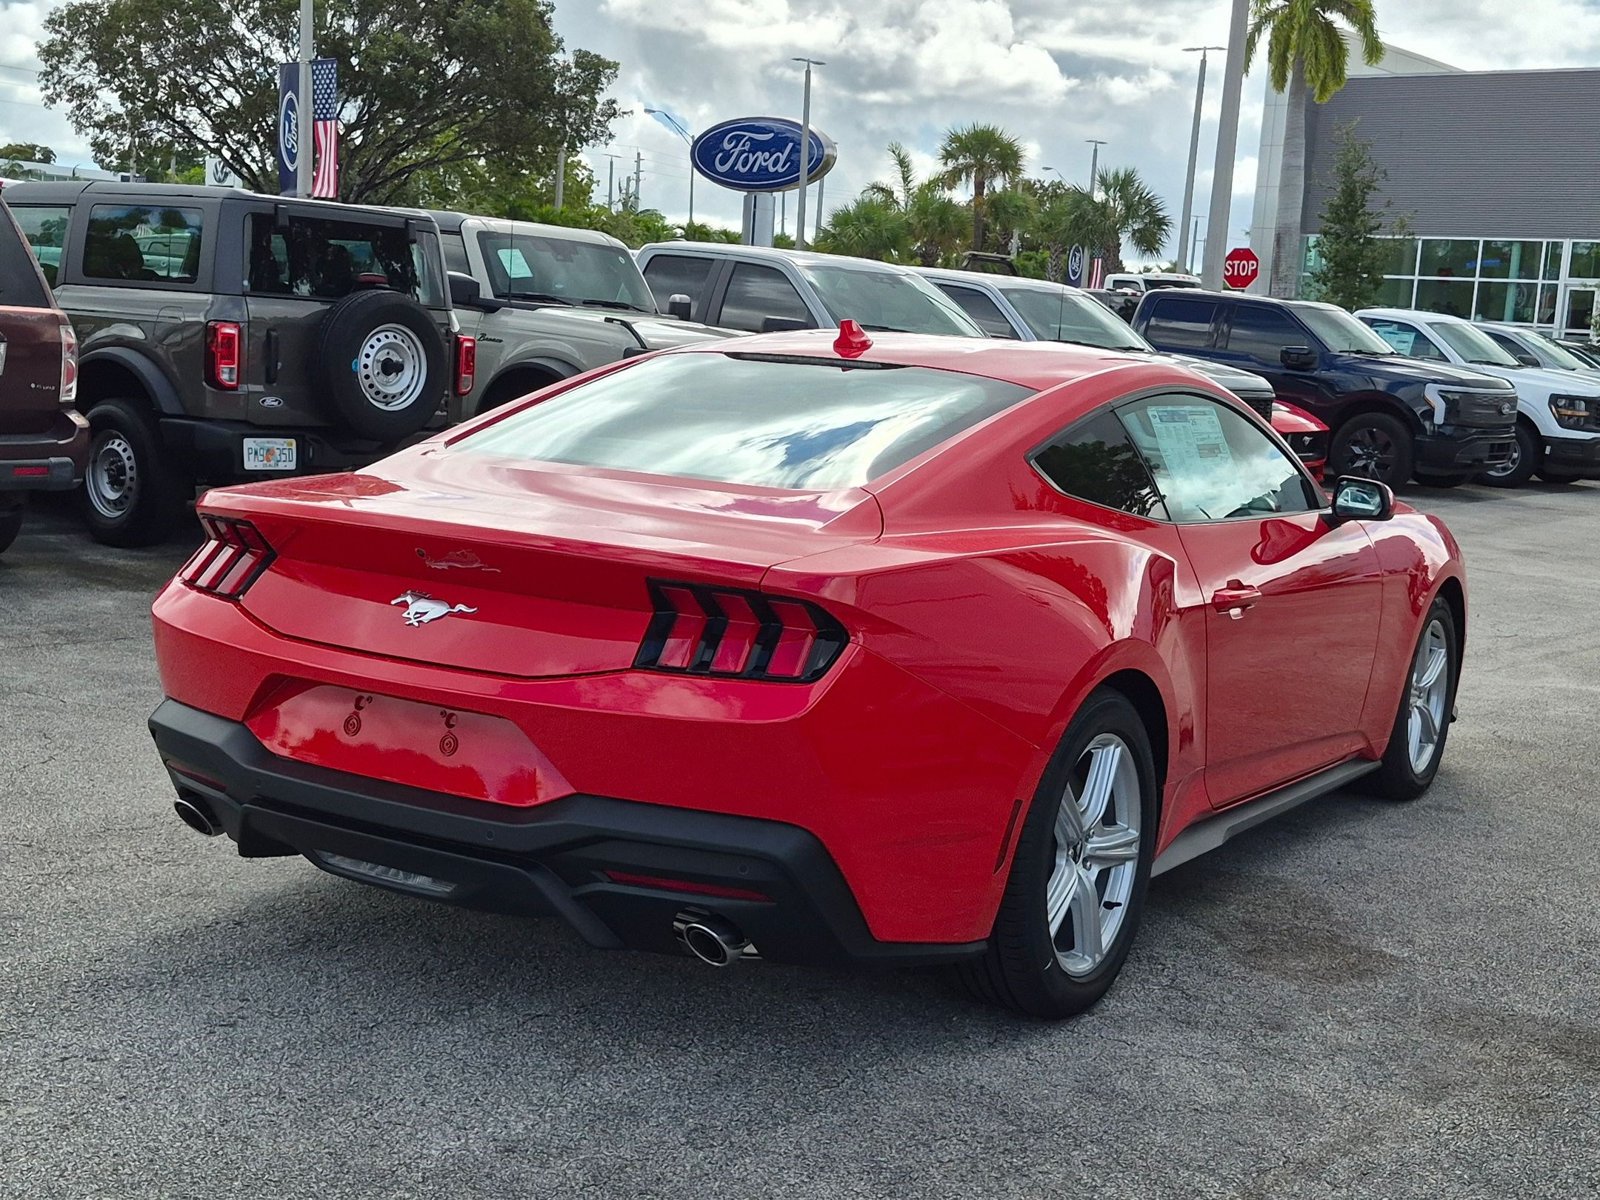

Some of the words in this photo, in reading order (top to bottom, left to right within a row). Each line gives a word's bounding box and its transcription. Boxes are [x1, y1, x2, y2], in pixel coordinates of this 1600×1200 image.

[284, 110, 298, 154] Ford
[714, 131, 794, 173] Ford
[1224, 260, 1257, 276] STOP
